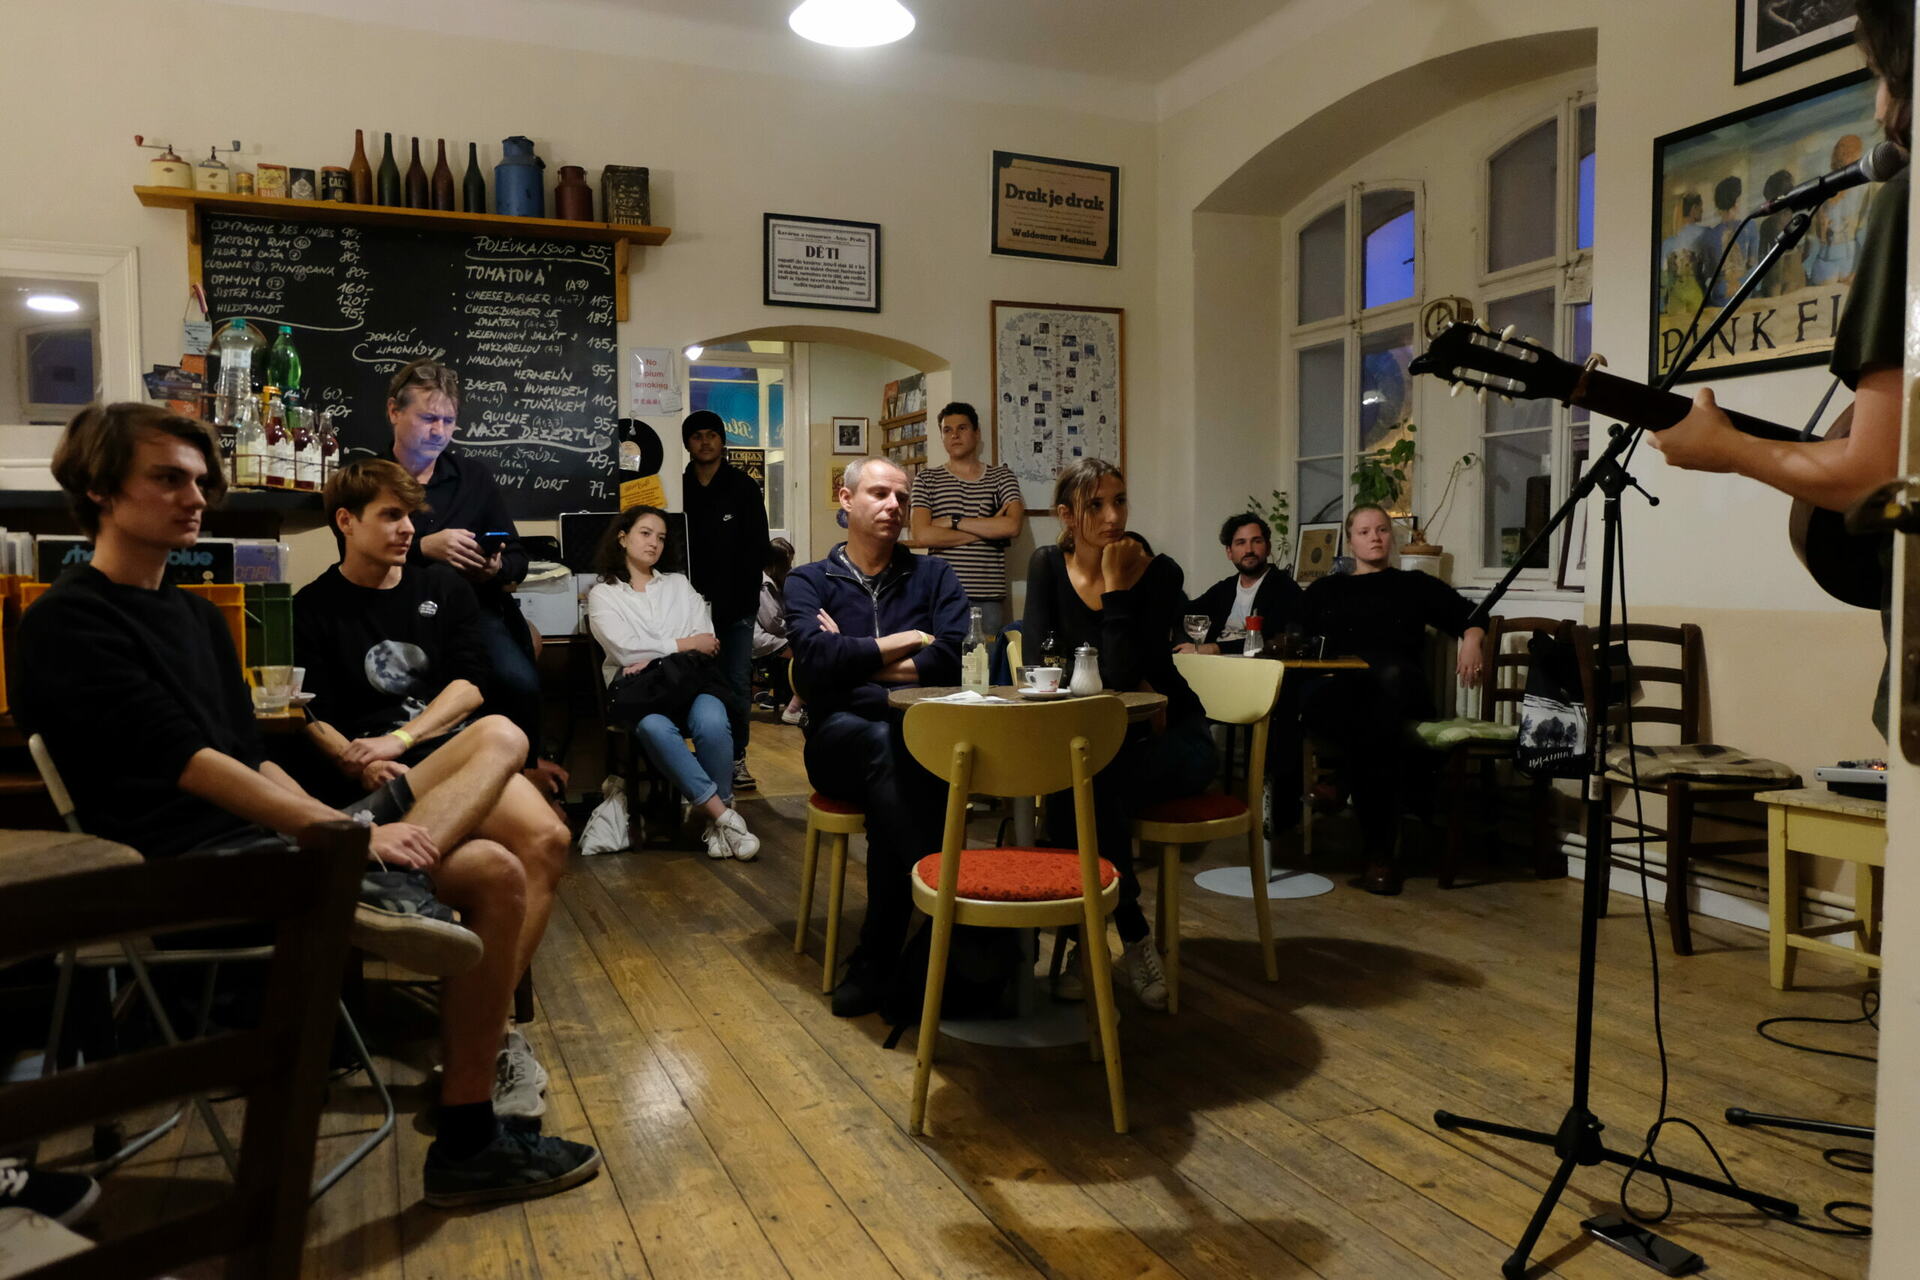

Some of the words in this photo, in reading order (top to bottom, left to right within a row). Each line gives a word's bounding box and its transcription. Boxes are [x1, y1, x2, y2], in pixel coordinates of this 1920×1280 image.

[1005, 183, 1048, 203] Drak
[1049, 190, 1063, 208] je
[1066, 193, 1104, 211] drak
[213, 234, 260, 248] FACTORY
[268, 237, 290, 249] RUM
[204, 260, 250, 270] CUBANEY
[213, 287, 248, 299] SISTER
[250, 290, 285, 301] ISLES
[465, 290, 551, 305] CHEESEBURGER
[464, 305, 541, 318] CHEESEBURGER
[1661, 308, 1777, 370] PINK
[464, 379, 508, 393] BAGETA
[524, 383, 589, 397] HUMMUSEM
[635, 382, 669, 391] smoking
[482, 410, 531, 426] QUICHE
[534, 479, 570, 491] DORT
